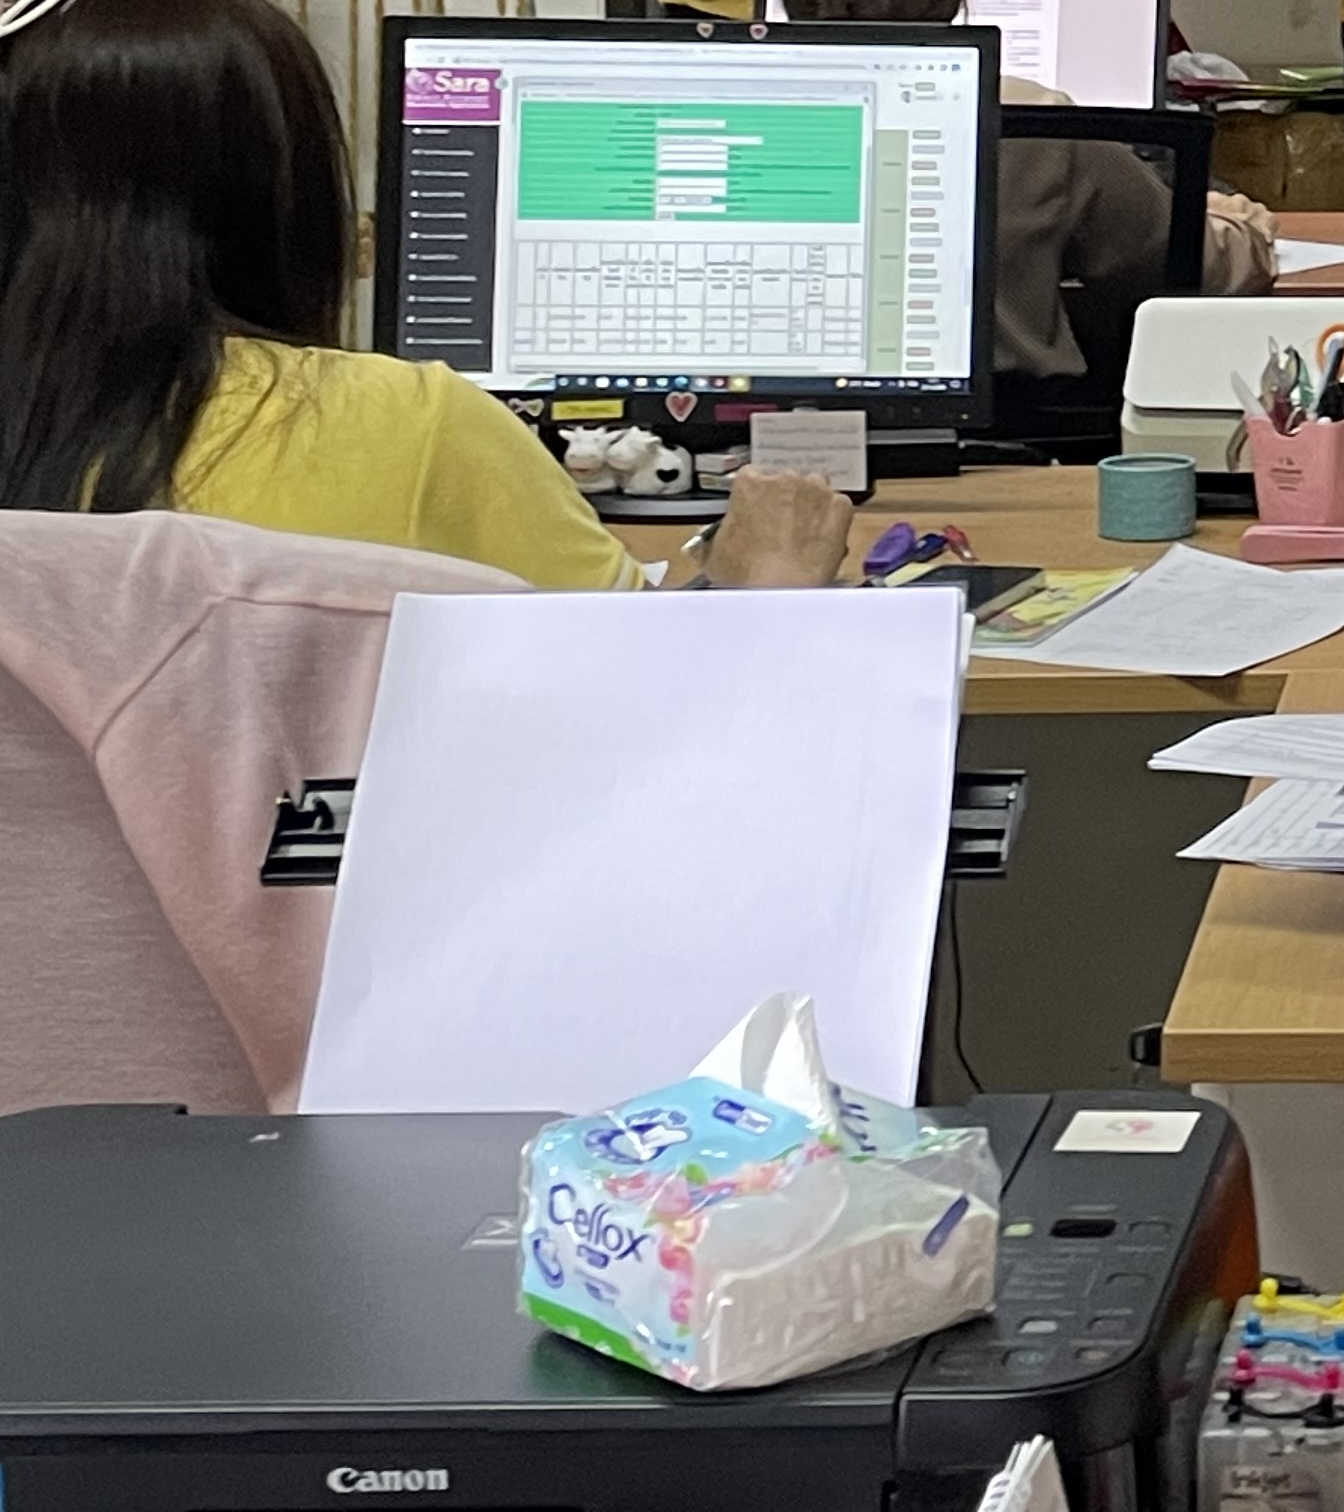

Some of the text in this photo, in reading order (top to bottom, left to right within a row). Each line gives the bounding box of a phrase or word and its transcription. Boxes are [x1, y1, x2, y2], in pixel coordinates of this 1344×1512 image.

[432, 70, 491, 93] Sara
[547, 1183, 649, 1263] Cellox
[326, 1467, 449, 1493] Canon
